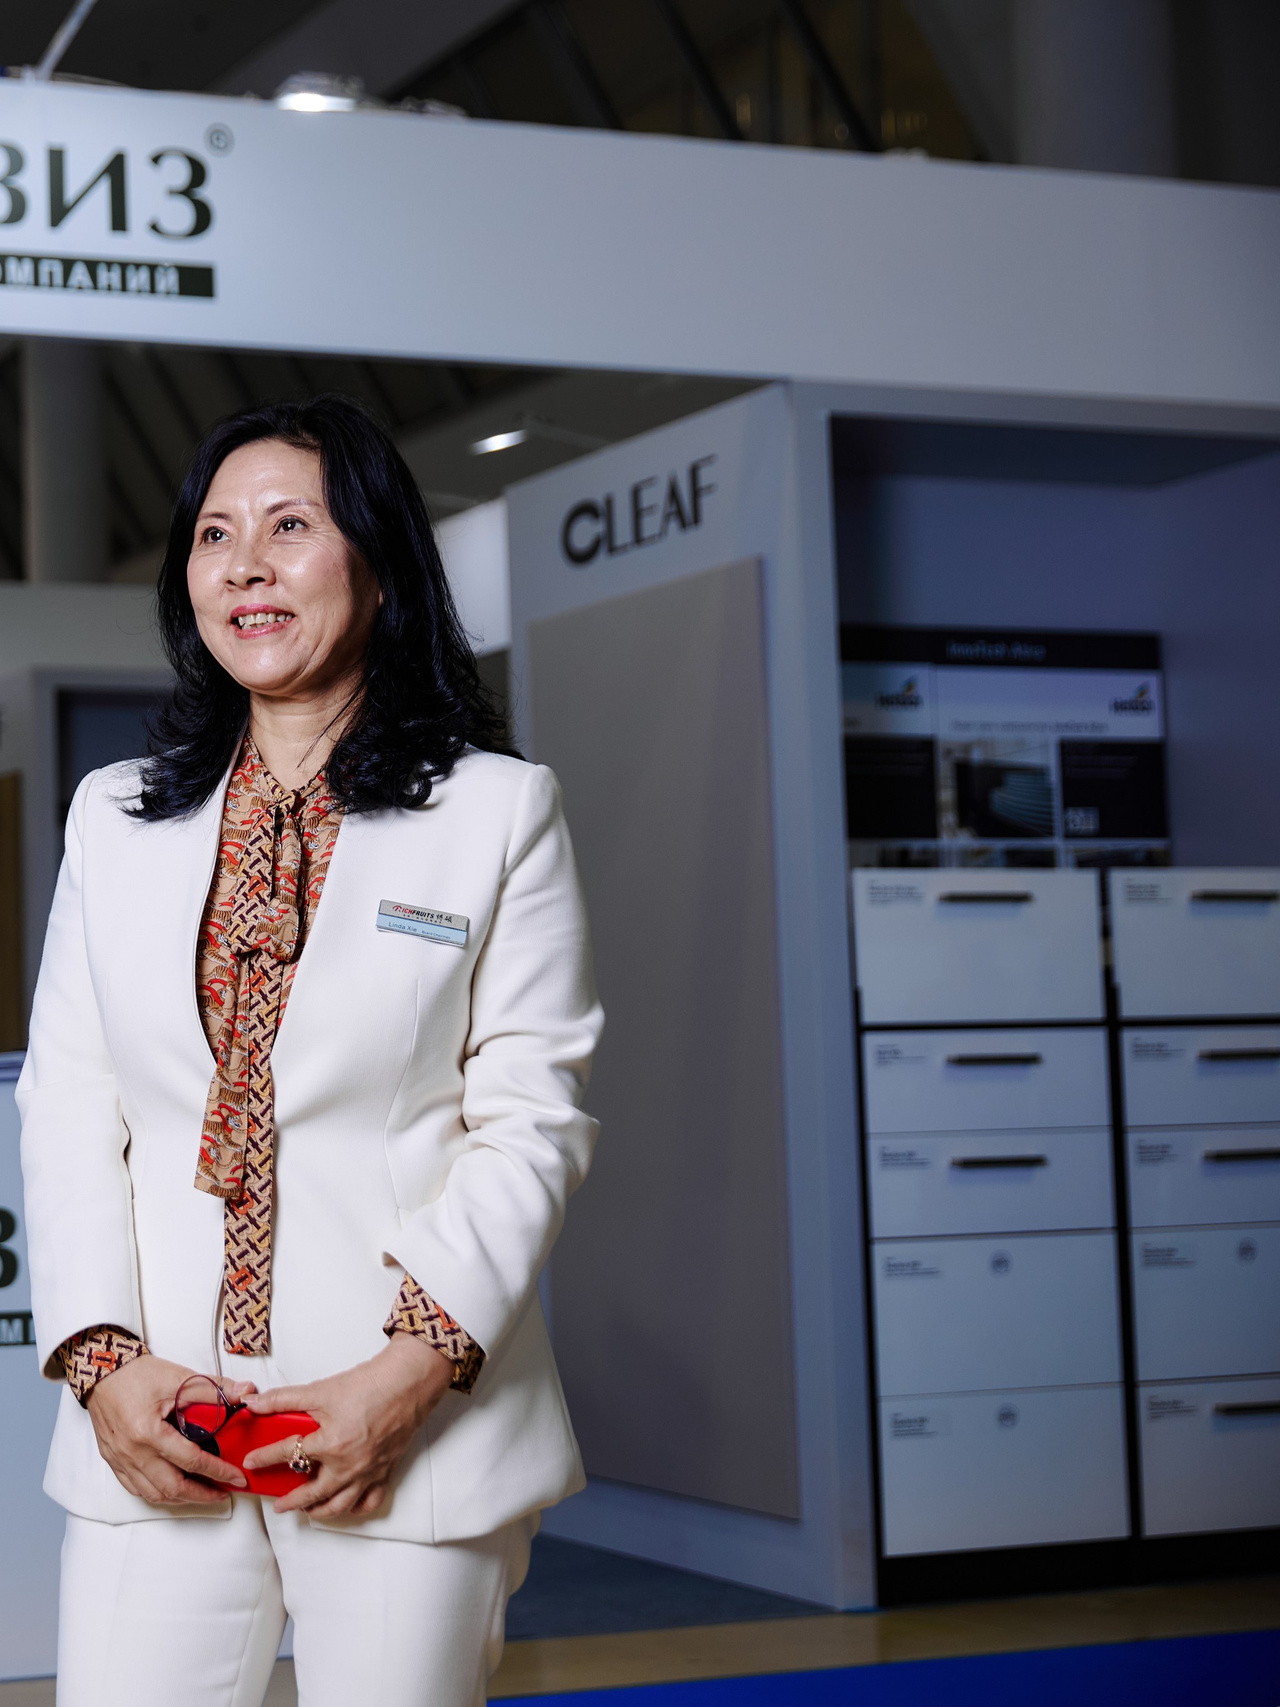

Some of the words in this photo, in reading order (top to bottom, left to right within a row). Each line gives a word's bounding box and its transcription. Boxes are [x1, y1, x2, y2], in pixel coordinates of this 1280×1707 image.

[561, 454, 718, 567] CLEAF
[388, 921, 406, 930] Linda
[406, 925, 418, 933] Xie
